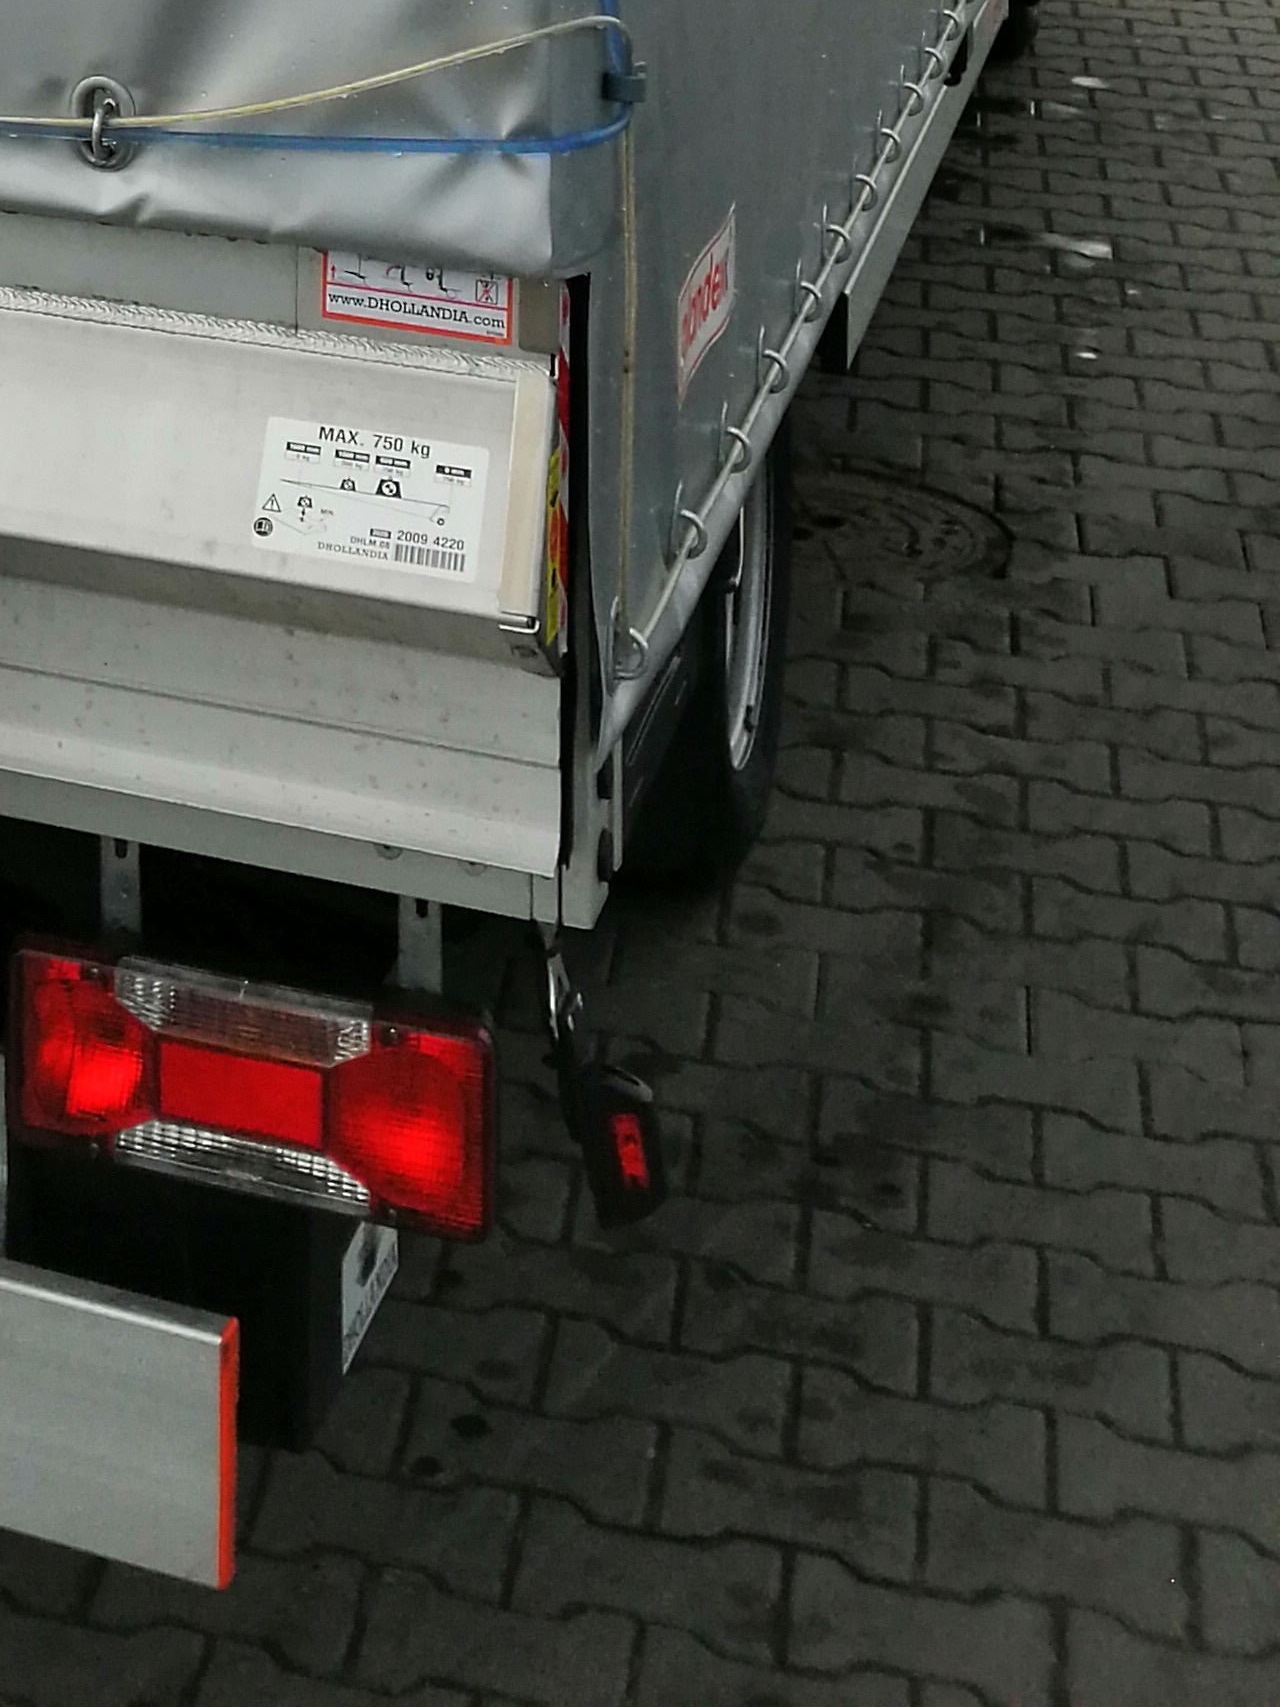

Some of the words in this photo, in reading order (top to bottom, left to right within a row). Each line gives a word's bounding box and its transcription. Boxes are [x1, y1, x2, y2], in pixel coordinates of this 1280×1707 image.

[328, 293, 506, 330] www.DHOLLANDIA.com
[318, 426, 365, 447] MAX.
[373, 434, 404, 453] 750
[410, 439, 431, 460] kg
[317, 541, 388, 561] DHOLLANDIA
[397, 530, 429, 545] 2009
[433, 536, 465, 552] 4220
